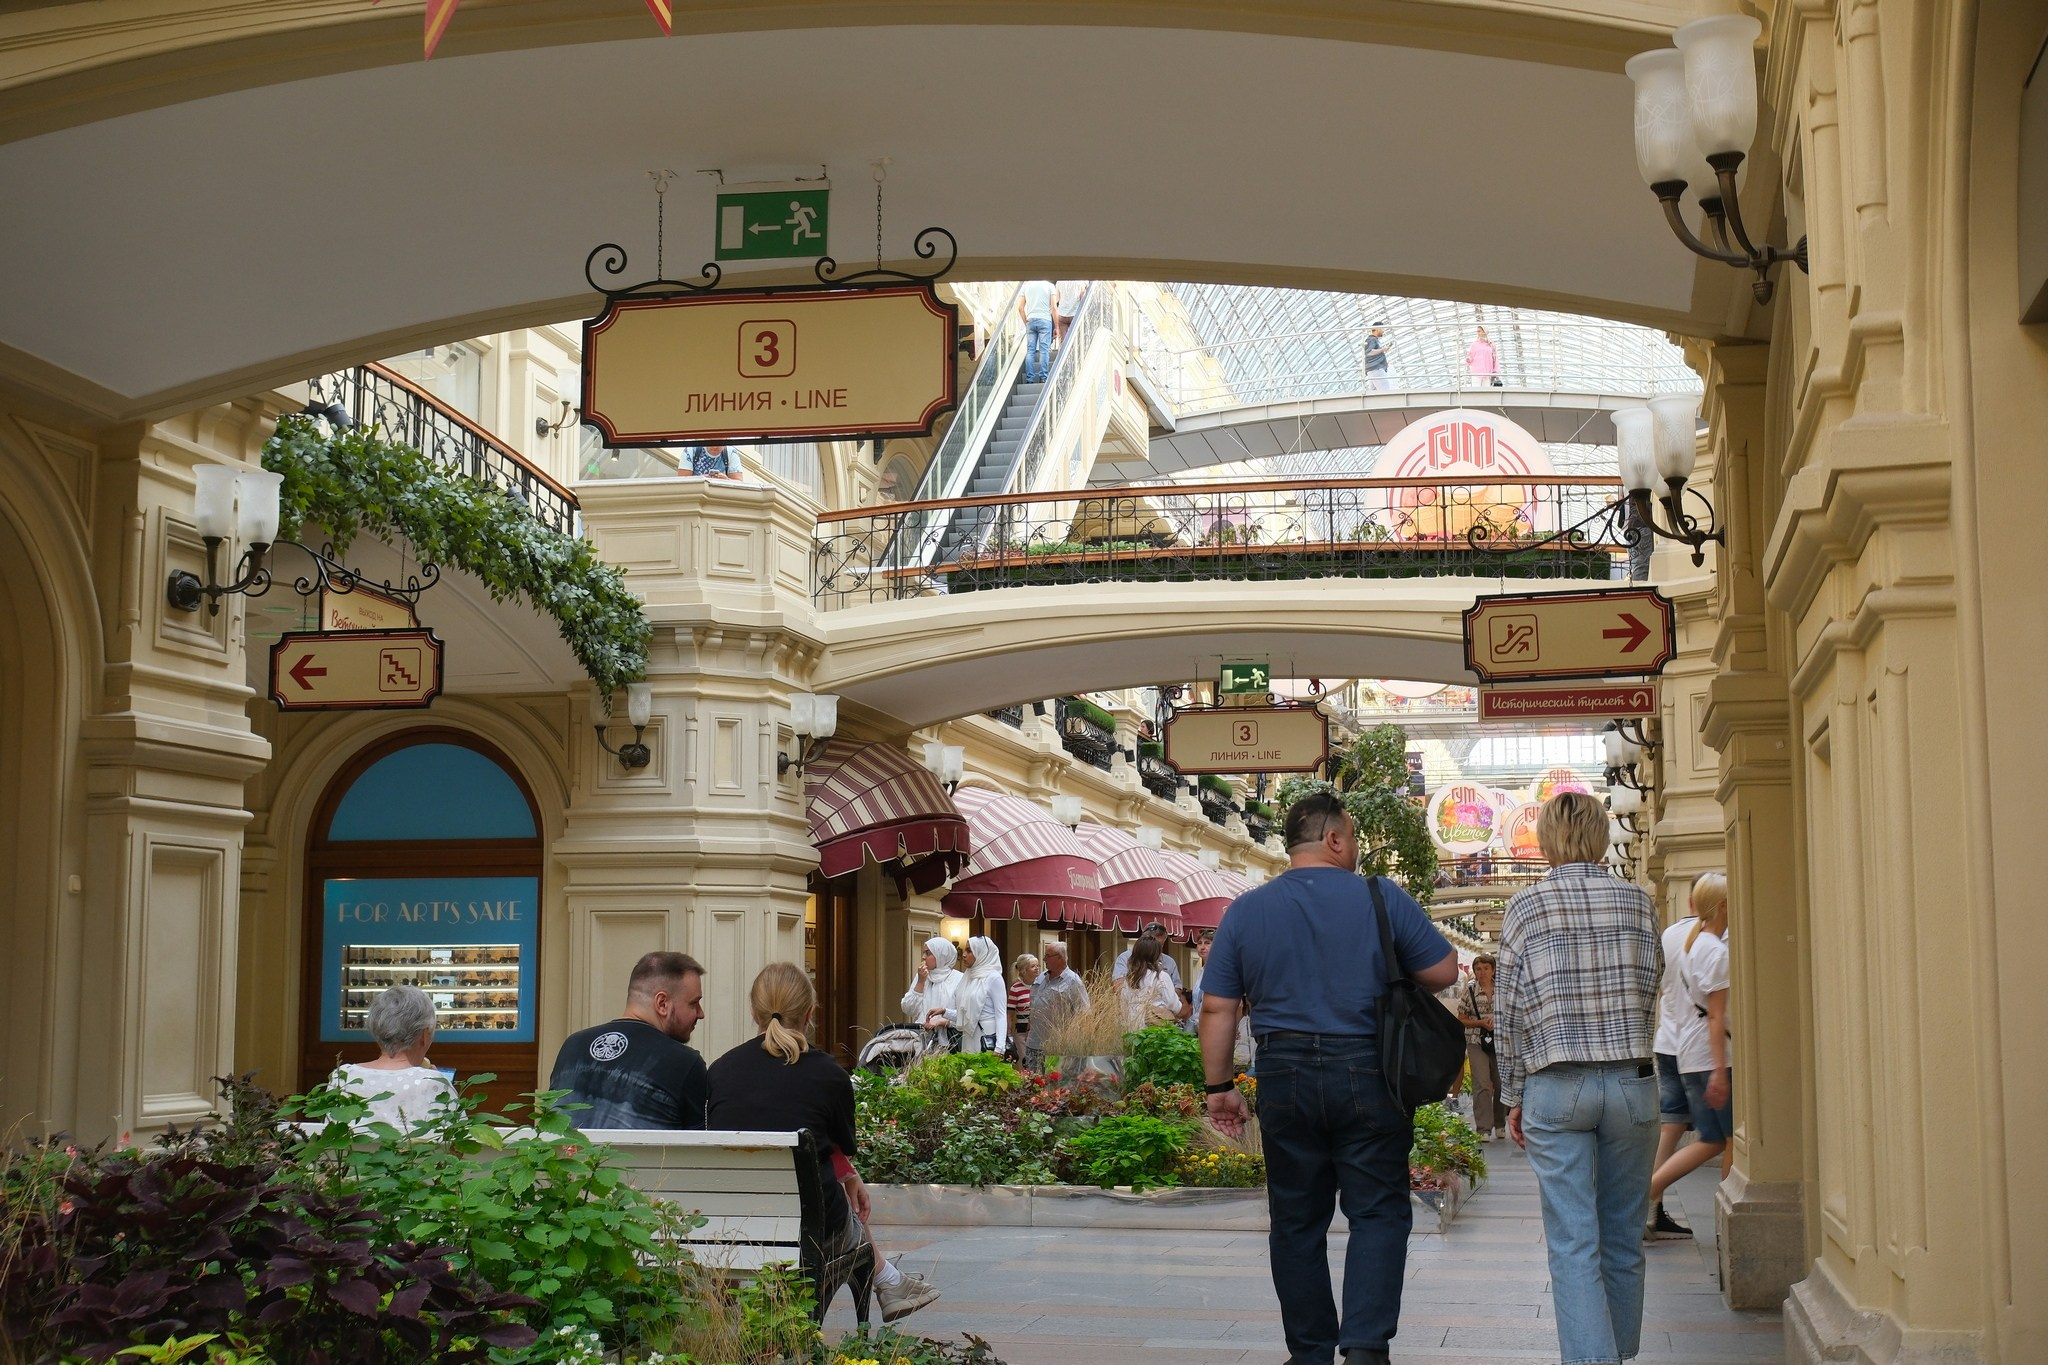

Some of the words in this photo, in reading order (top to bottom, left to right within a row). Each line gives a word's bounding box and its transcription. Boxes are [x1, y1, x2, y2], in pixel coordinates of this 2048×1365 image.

[754, 331, 780, 367] 3
[684, 391, 772, 414] ЛИНИЯ
[794, 388, 848, 410] LINE
[1427, 422, 1495, 470] ГУМ
[1492, 695, 1575, 712] Исторический
[1578, 694, 1625, 710] туалет
[1239, 725, 1251, 742] 3
[1210, 751, 1249, 761] ЛИНИЯ
[1257, 750, 1282, 760] LINE
[1452, 787, 1475, 804] ГУМ
[1439, 822, 1488, 842] Цветы
[338, 902, 389, 923] FOR
[396, 901, 462, 924] ART'S
[465, 900, 523, 925] SAKE
